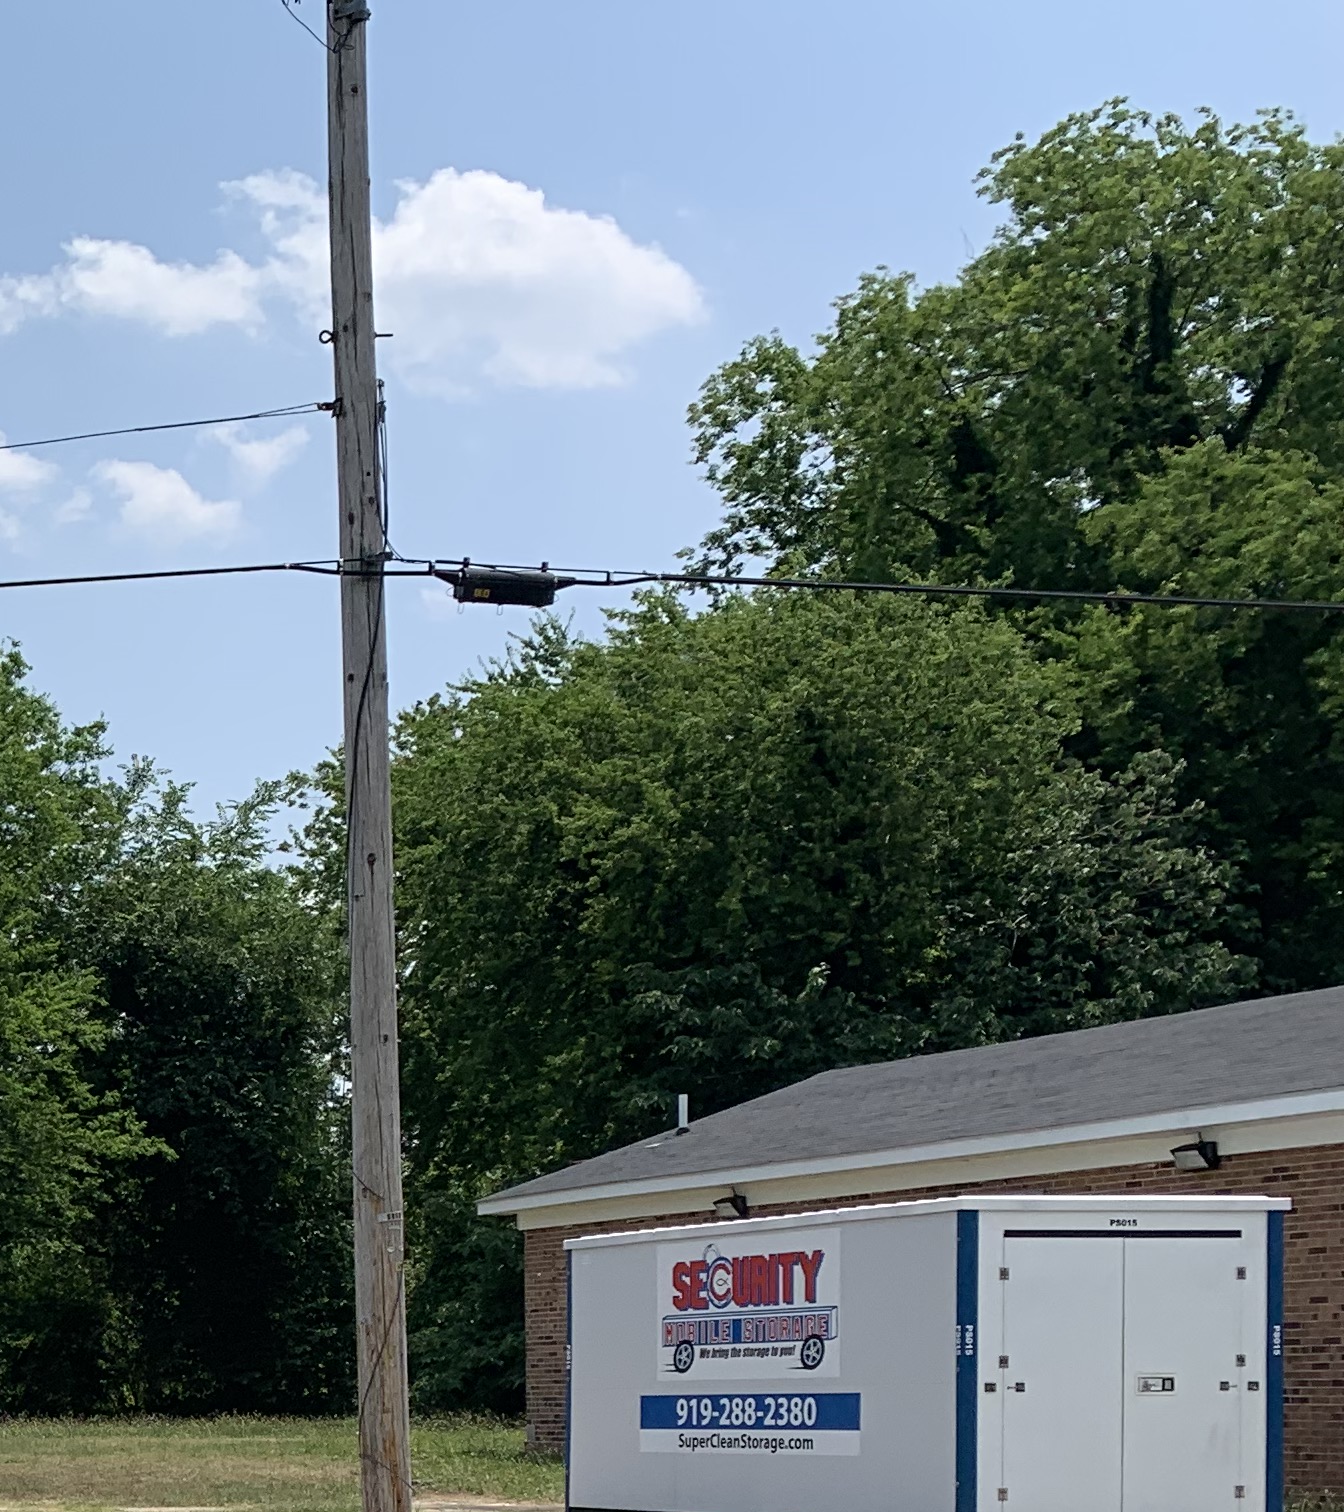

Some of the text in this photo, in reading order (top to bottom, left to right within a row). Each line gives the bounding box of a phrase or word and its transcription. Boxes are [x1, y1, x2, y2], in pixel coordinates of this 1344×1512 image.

[1110, 1219, 1138, 1227] PS015
[673, 1250, 825, 1311] SECURITY
[665, 1315, 829, 1345] MOBILE STORAGE
[965, 1325, 974, 1355] PS015
[1273, 1325, 1281, 1355] PS015
[699, 1345, 796, 1359] We bring the storage to you!
[675, 1396, 817, 1427] 919-288-2380
[678, 1433, 814, 1454] SuperCleanStorage.com
